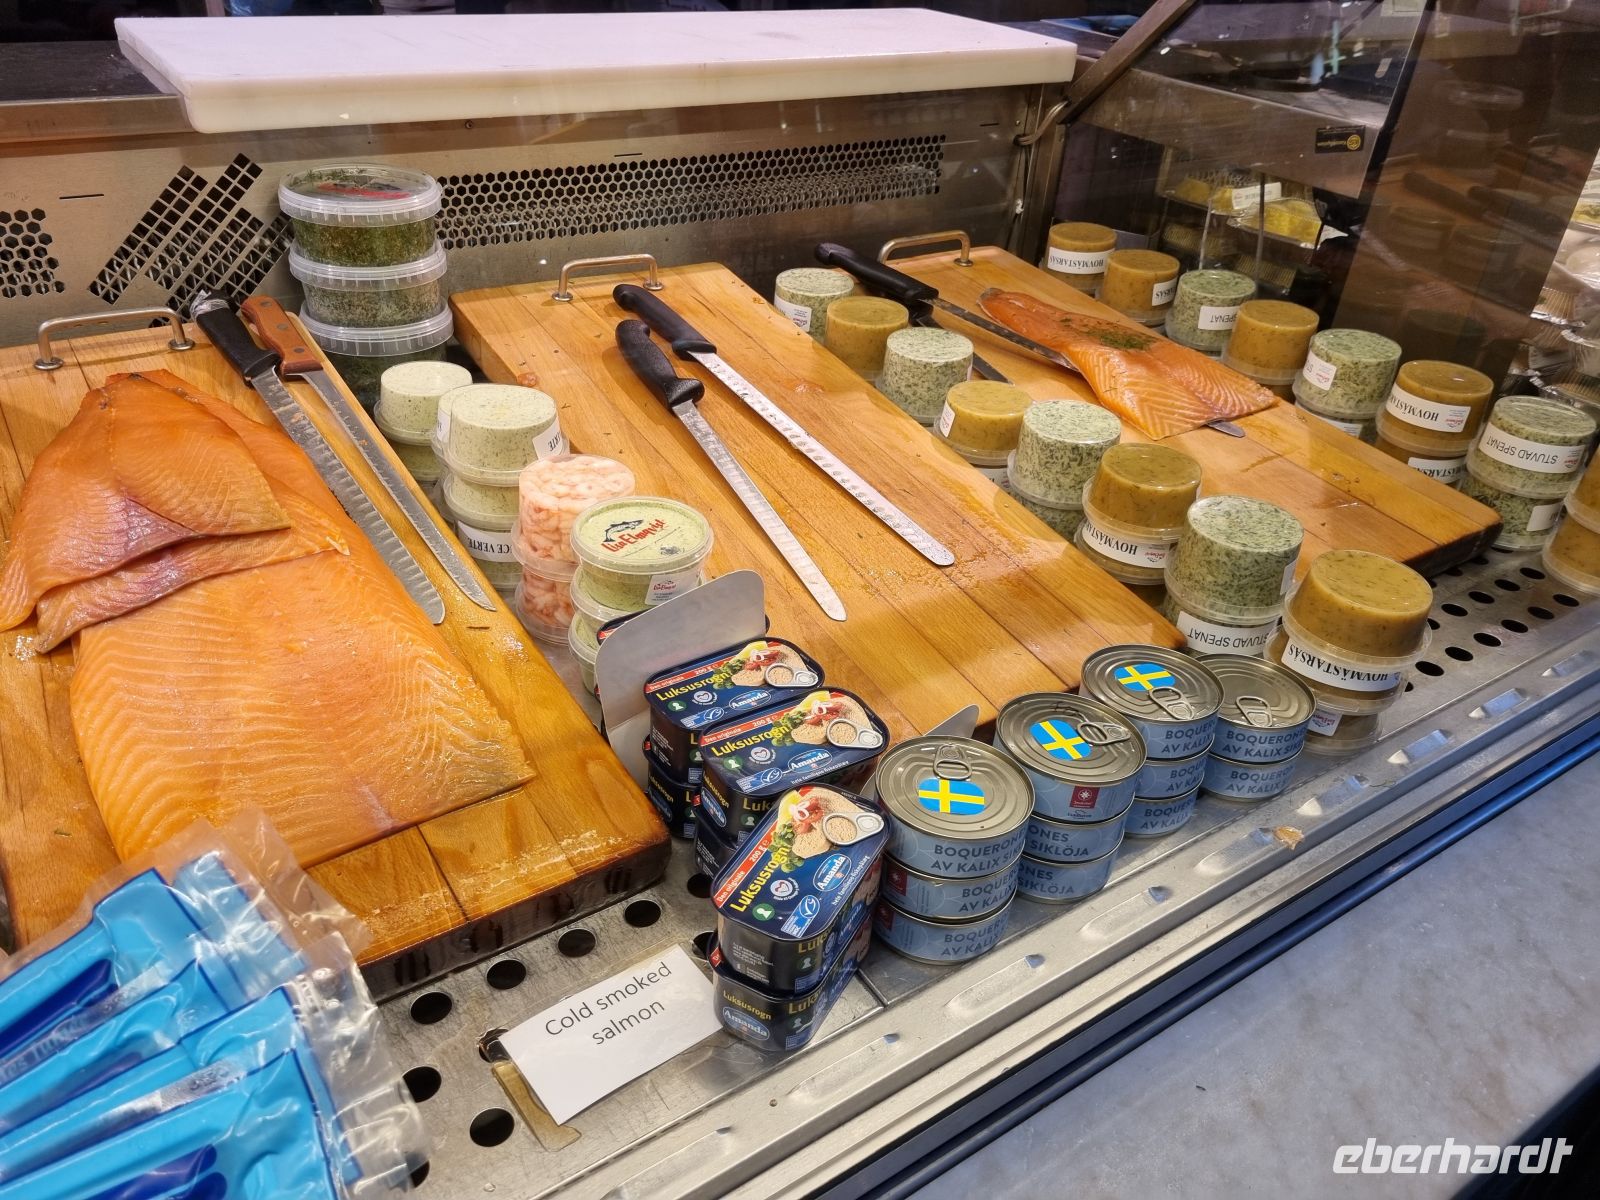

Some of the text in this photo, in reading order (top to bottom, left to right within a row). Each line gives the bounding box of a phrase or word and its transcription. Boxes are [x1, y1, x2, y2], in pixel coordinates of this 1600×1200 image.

[1486, 435, 1517, 456] SPENAT
[1517, 449, 1559, 464] STUVAD
[468, 537, 495, 553] VERTE
[1187, 628, 1231, 648] SPENAT
[1288, 643, 1389, 682] HOVMÄSTARSÅS
[656, 672, 732, 701] Luksusrogn
[731, 691, 768, 709] Amanda
[753, 718, 766, 727] 200
[711, 725, 790, 757] Luksusrogn
[1162, 744, 1180, 753] AV
[790, 751, 830, 770] Amanda
[1222, 744, 1242, 754] AV
[1244, 747, 1284, 758] KALIX
[1166, 782, 1183, 792] AV
[1225, 783, 1281, 794] AV KALIX
[1140, 821, 1160, 830] AV
[1030, 840, 1089, 857] SIKLÖJA
[818, 855, 846, 890] Amanda
[931, 860, 953, 871] AV
[957, 855, 1000, 873] KALIX
[717, 891, 727, 902] Den
[727, 870, 746, 892] originale
[750, 850, 761, 862] 200
[730, 846, 790, 913] Luksusrogn
[1017, 876, 1075, 895] SIKLÖJA
[958, 901, 979, 912] AV
[940, 948, 961, 956] AV
[545, 961, 673, 1036] Cold smoked
[723, 990, 772, 1021] Luksusrogn
[592, 1000, 666, 1045] salmon
[724, 1010, 768, 1037] Amanda
